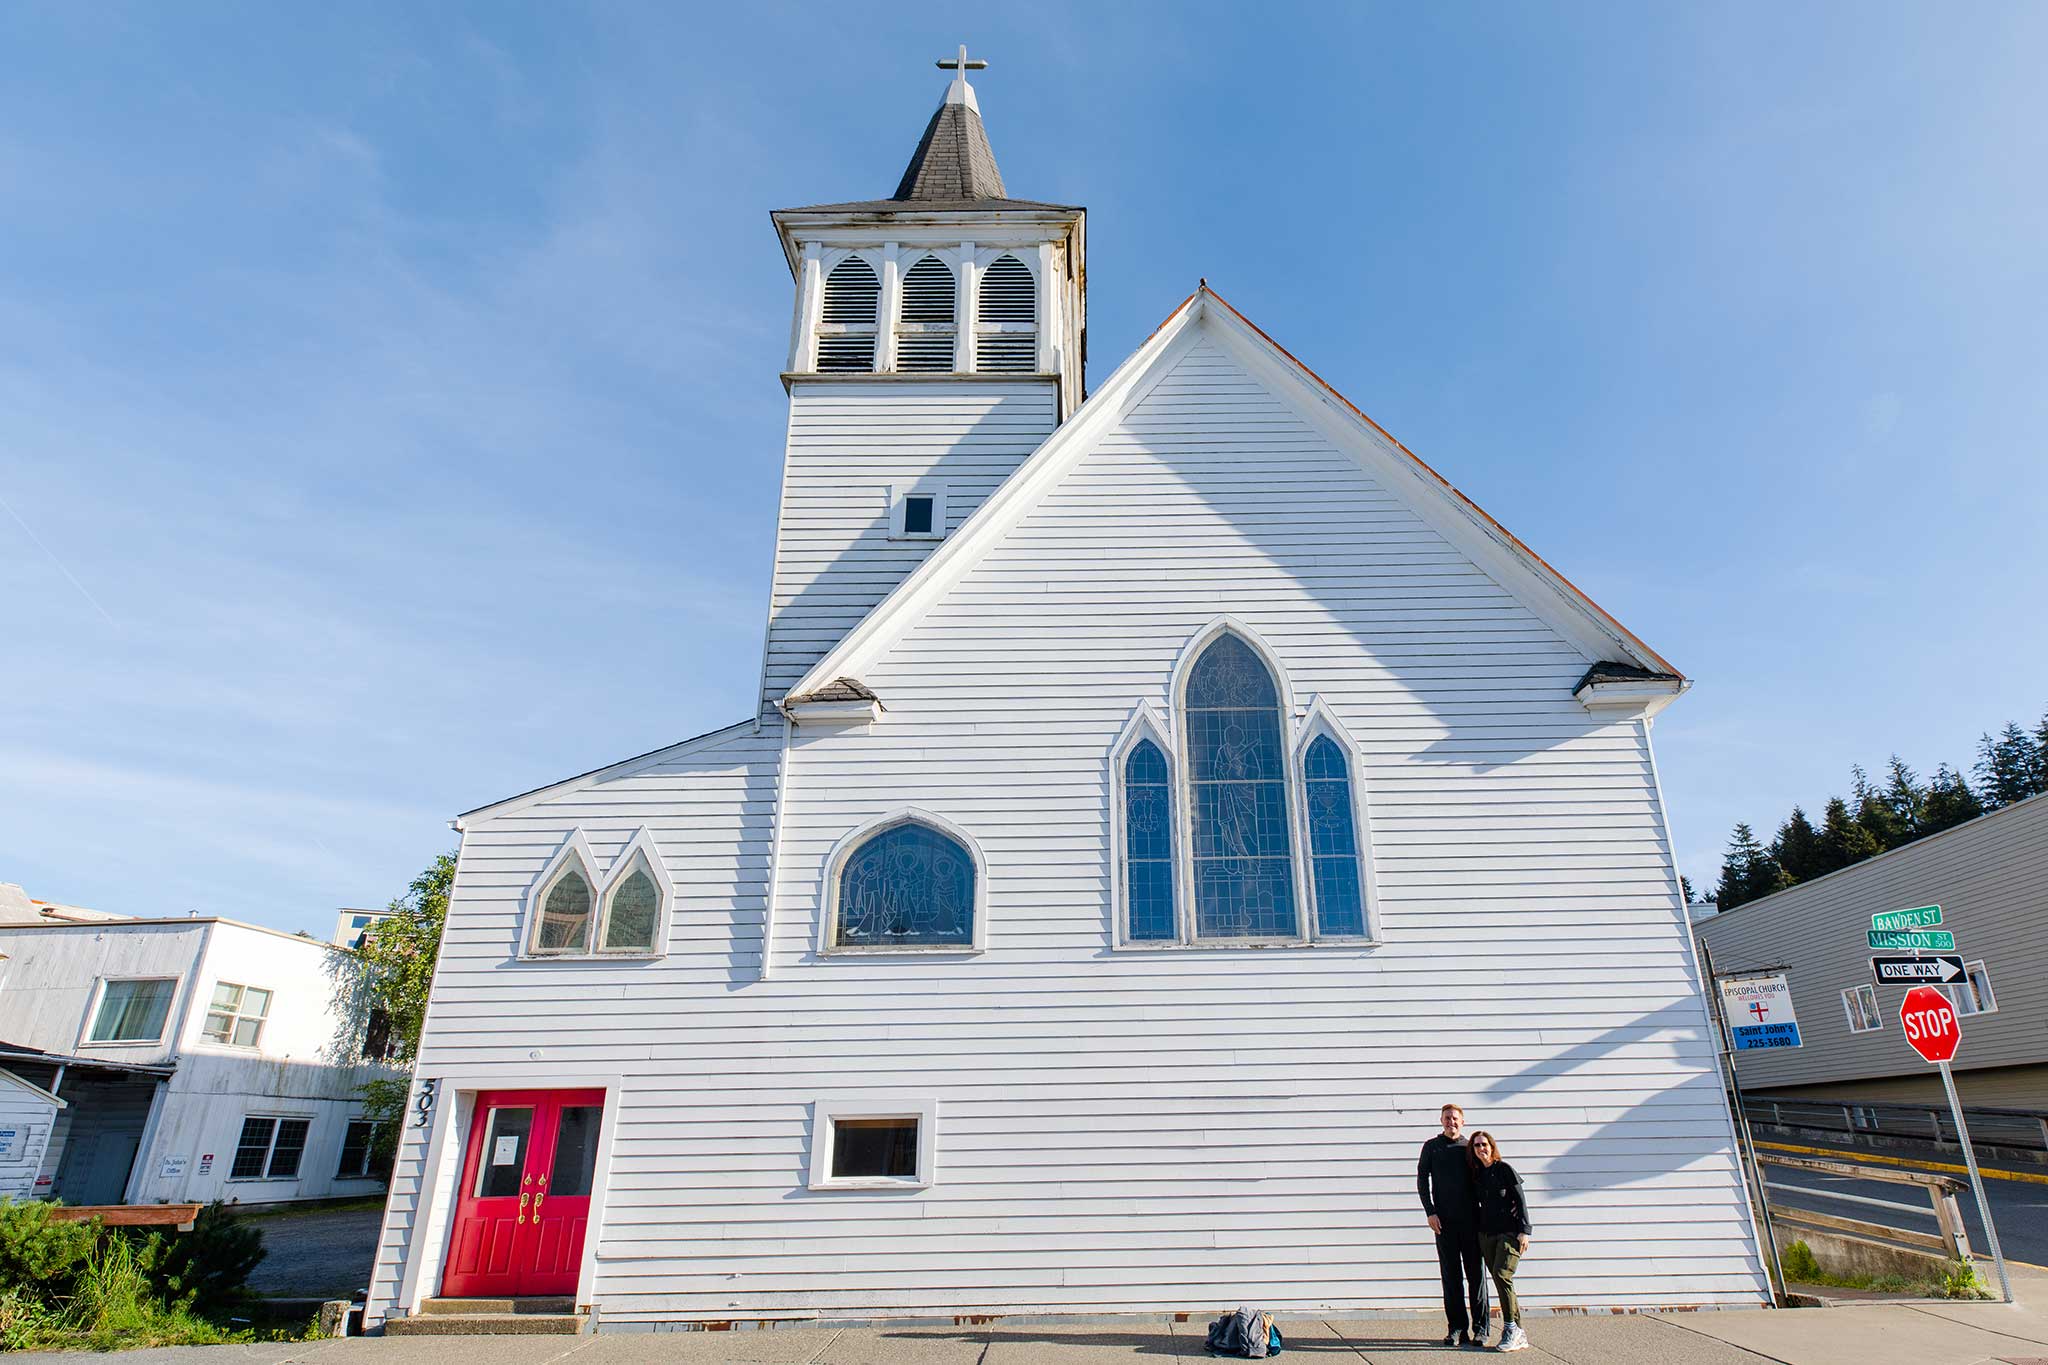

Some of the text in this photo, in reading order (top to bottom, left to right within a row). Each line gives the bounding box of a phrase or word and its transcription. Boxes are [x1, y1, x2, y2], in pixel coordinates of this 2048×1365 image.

[1877, 910, 1936, 931] BAWDEN ST
[1870, 933, 1931, 946] MISSION
[1884, 964, 1940, 976] ONE WAY
[1725, 984, 1786, 996] EPISCOPAL CHURCH
[1739, 1024, 1793, 1036] Saint John's
[1905, 1008, 1952, 1040] STOP
[1747, 1037, 1791, 1048] 225-3680
[415, 1078, 436, 1127] 503
